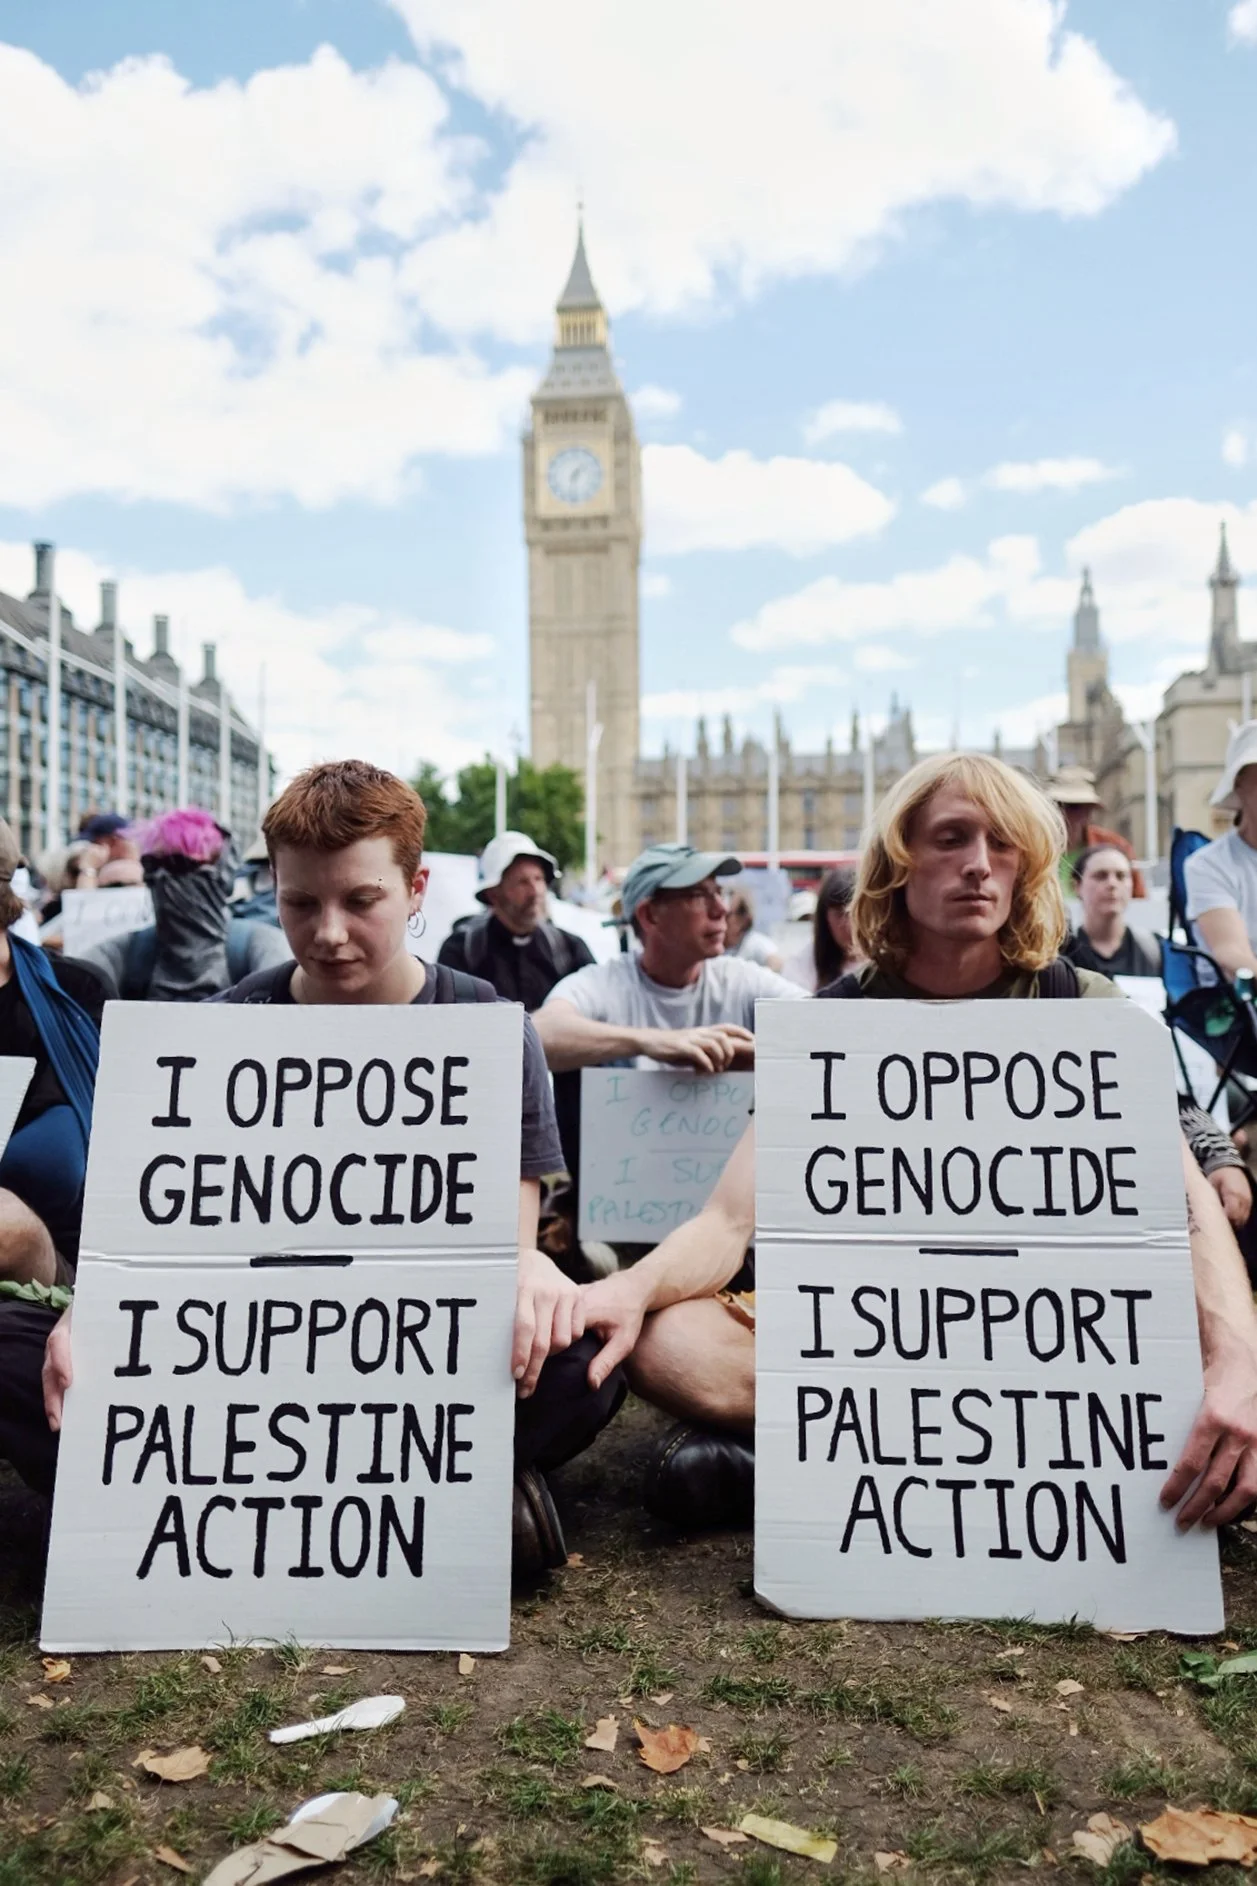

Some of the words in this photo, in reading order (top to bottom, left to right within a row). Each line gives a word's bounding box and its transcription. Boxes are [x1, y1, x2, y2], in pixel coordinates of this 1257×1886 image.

[151, 1055, 197, 1128] I
[226, 1055, 470, 1129] OPPOSE
[606, 1075, 631, 1105] I
[669, 1080, 749, 1106] OPPO
[630, 1107, 740, 1139] GENOC
[809, 1051, 847, 1121] I
[877, 1050, 1122, 1121] OPPOSE
[139, 1152, 478, 1227] GENOCIDE
[612, 1156, 639, 1186] I
[804, 1144, 1139, 1218] GENOCIDE
[113, 1299, 160, 1378] I
[172, 1297, 478, 1377] SUPPORT
[797, 1284, 835, 1359] I
[850, 1285, 1153, 1366] SUPPORT
[101, 1402, 475, 1486] PALESTINE
[797, 1385, 1168, 1471] PALESTINE
[135, 1494, 426, 1580] ACTION
[839, 1474, 1127, 1565] ACTION
